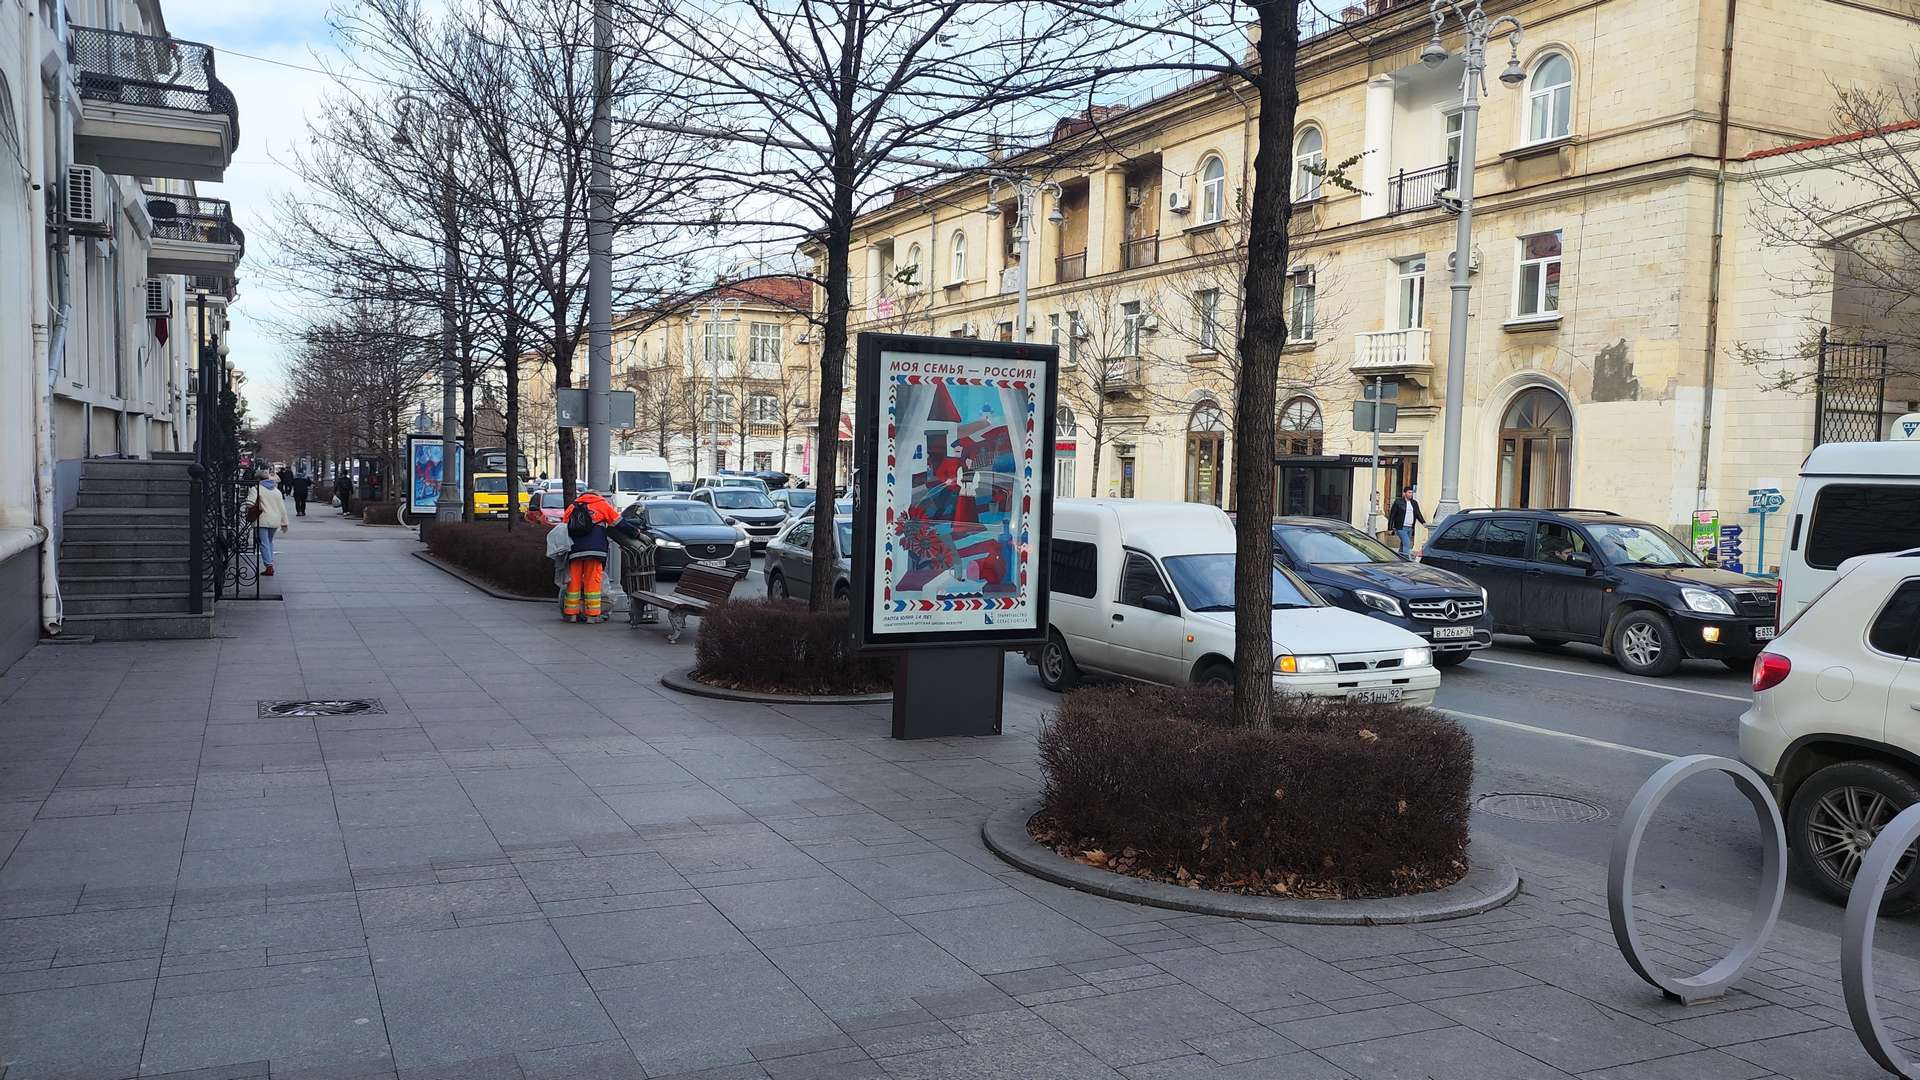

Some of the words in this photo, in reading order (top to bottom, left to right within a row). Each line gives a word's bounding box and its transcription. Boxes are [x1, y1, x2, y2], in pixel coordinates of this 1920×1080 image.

[889, 361, 919, 373] МОЯ
[923, 363, 964, 375] СЕМЬЯ
[984, 366, 1037, 379] РОССИЯ!
